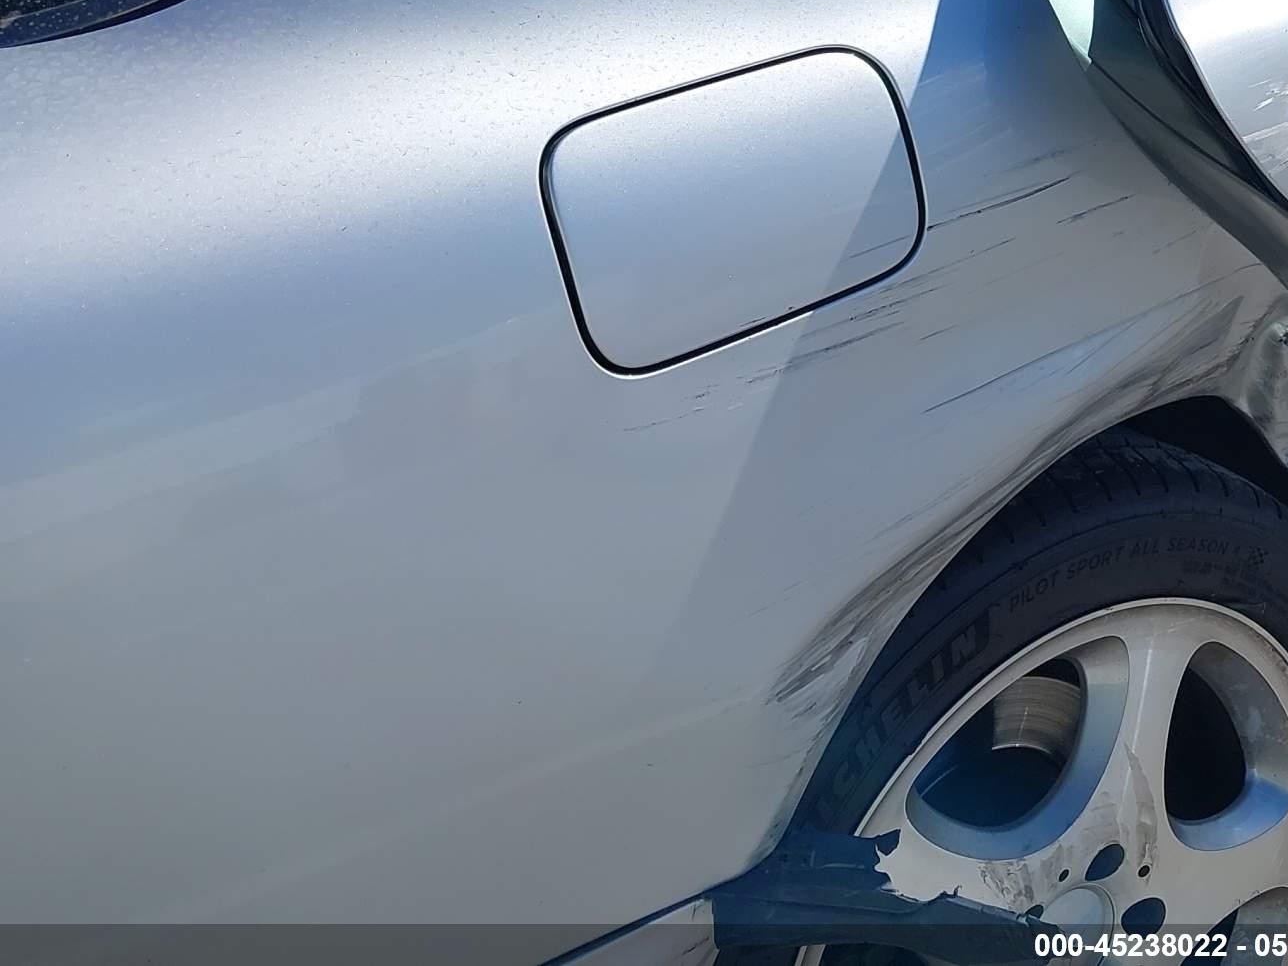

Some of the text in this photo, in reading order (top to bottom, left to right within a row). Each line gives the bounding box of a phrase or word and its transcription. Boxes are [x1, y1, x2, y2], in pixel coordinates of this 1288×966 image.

[1009, 571, 1058, 612] PILOT
[1067, 545, 1124, 580] SPORT
[1129, 542, 1160, 561] ALL
[1167, 537, 1231, 556] SEASON
